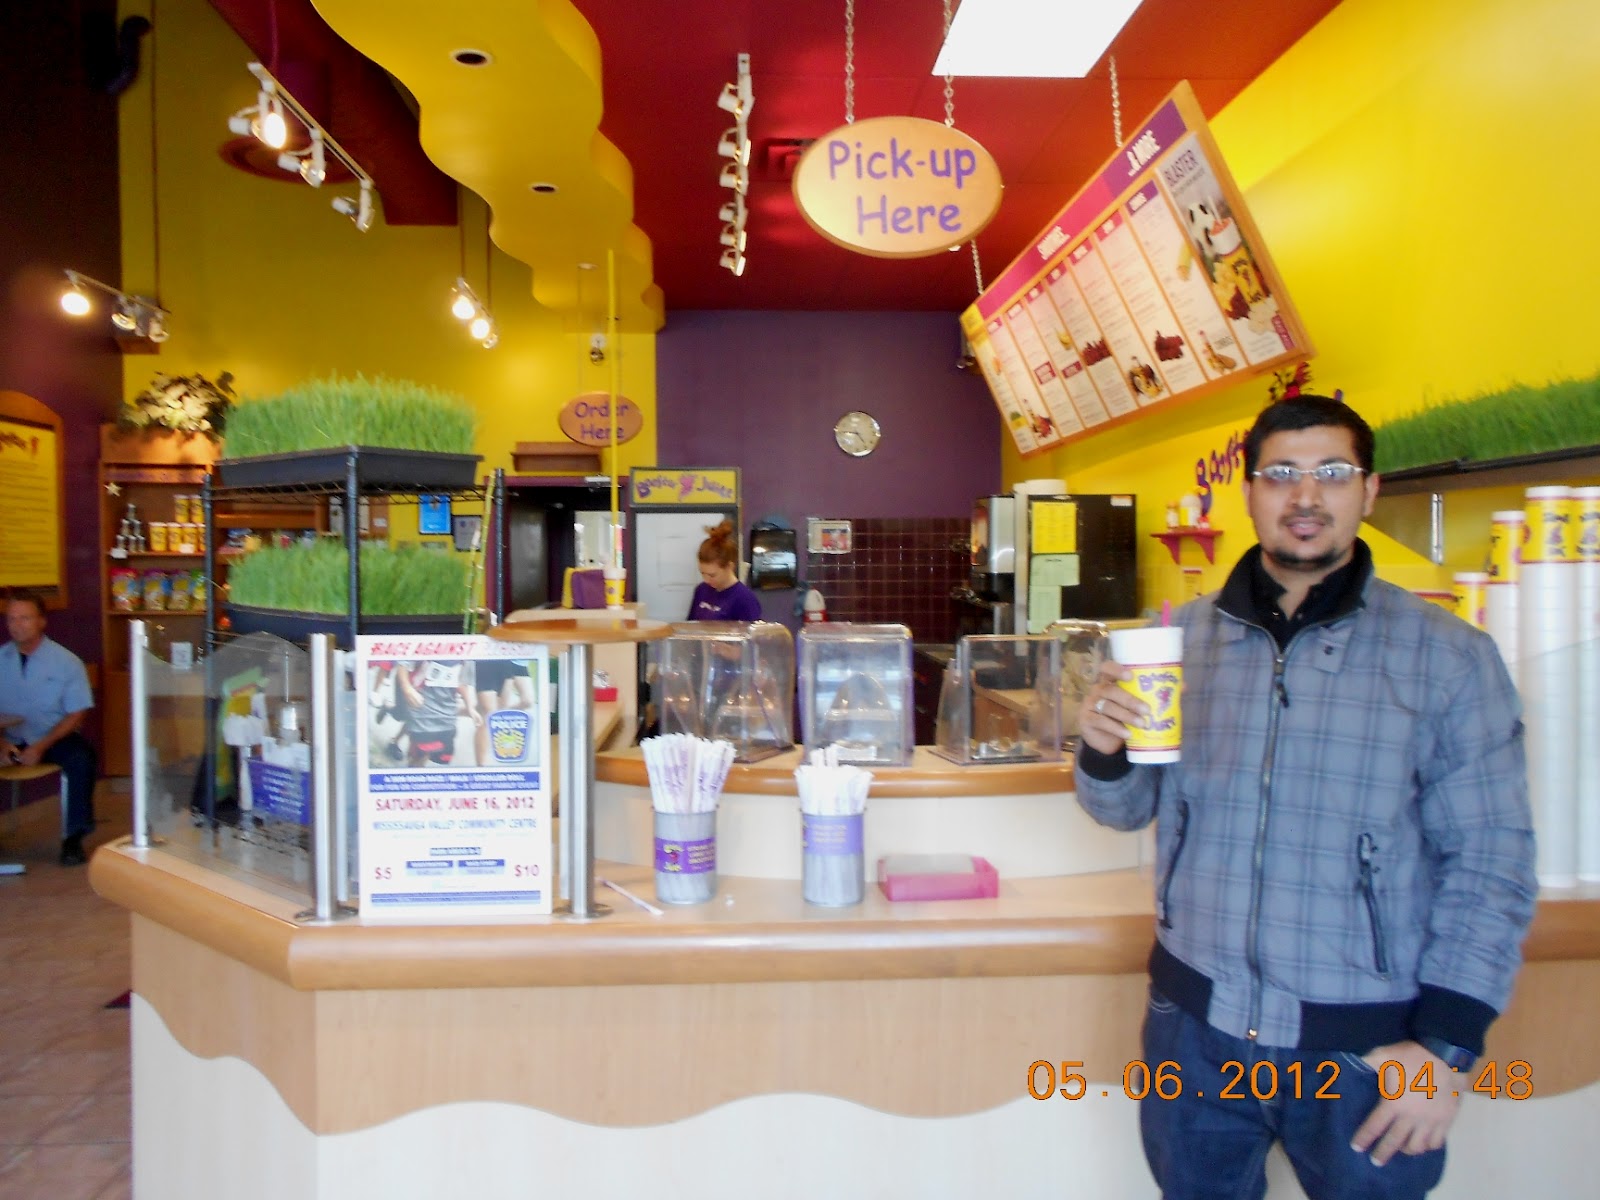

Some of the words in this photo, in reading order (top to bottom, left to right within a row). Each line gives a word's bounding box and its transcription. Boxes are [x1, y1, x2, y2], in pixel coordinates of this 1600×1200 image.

[828, 137, 977, 190] Pick-up
[856, 194, 963, 236] Here
[413, 642, 478, 656] AGAINST
[448, 797, 479, 811] JUNE
[506, 796, 535, 810] 2012
[375, 867, 392, 880] $5
[514, 864, 540, 878] $10
